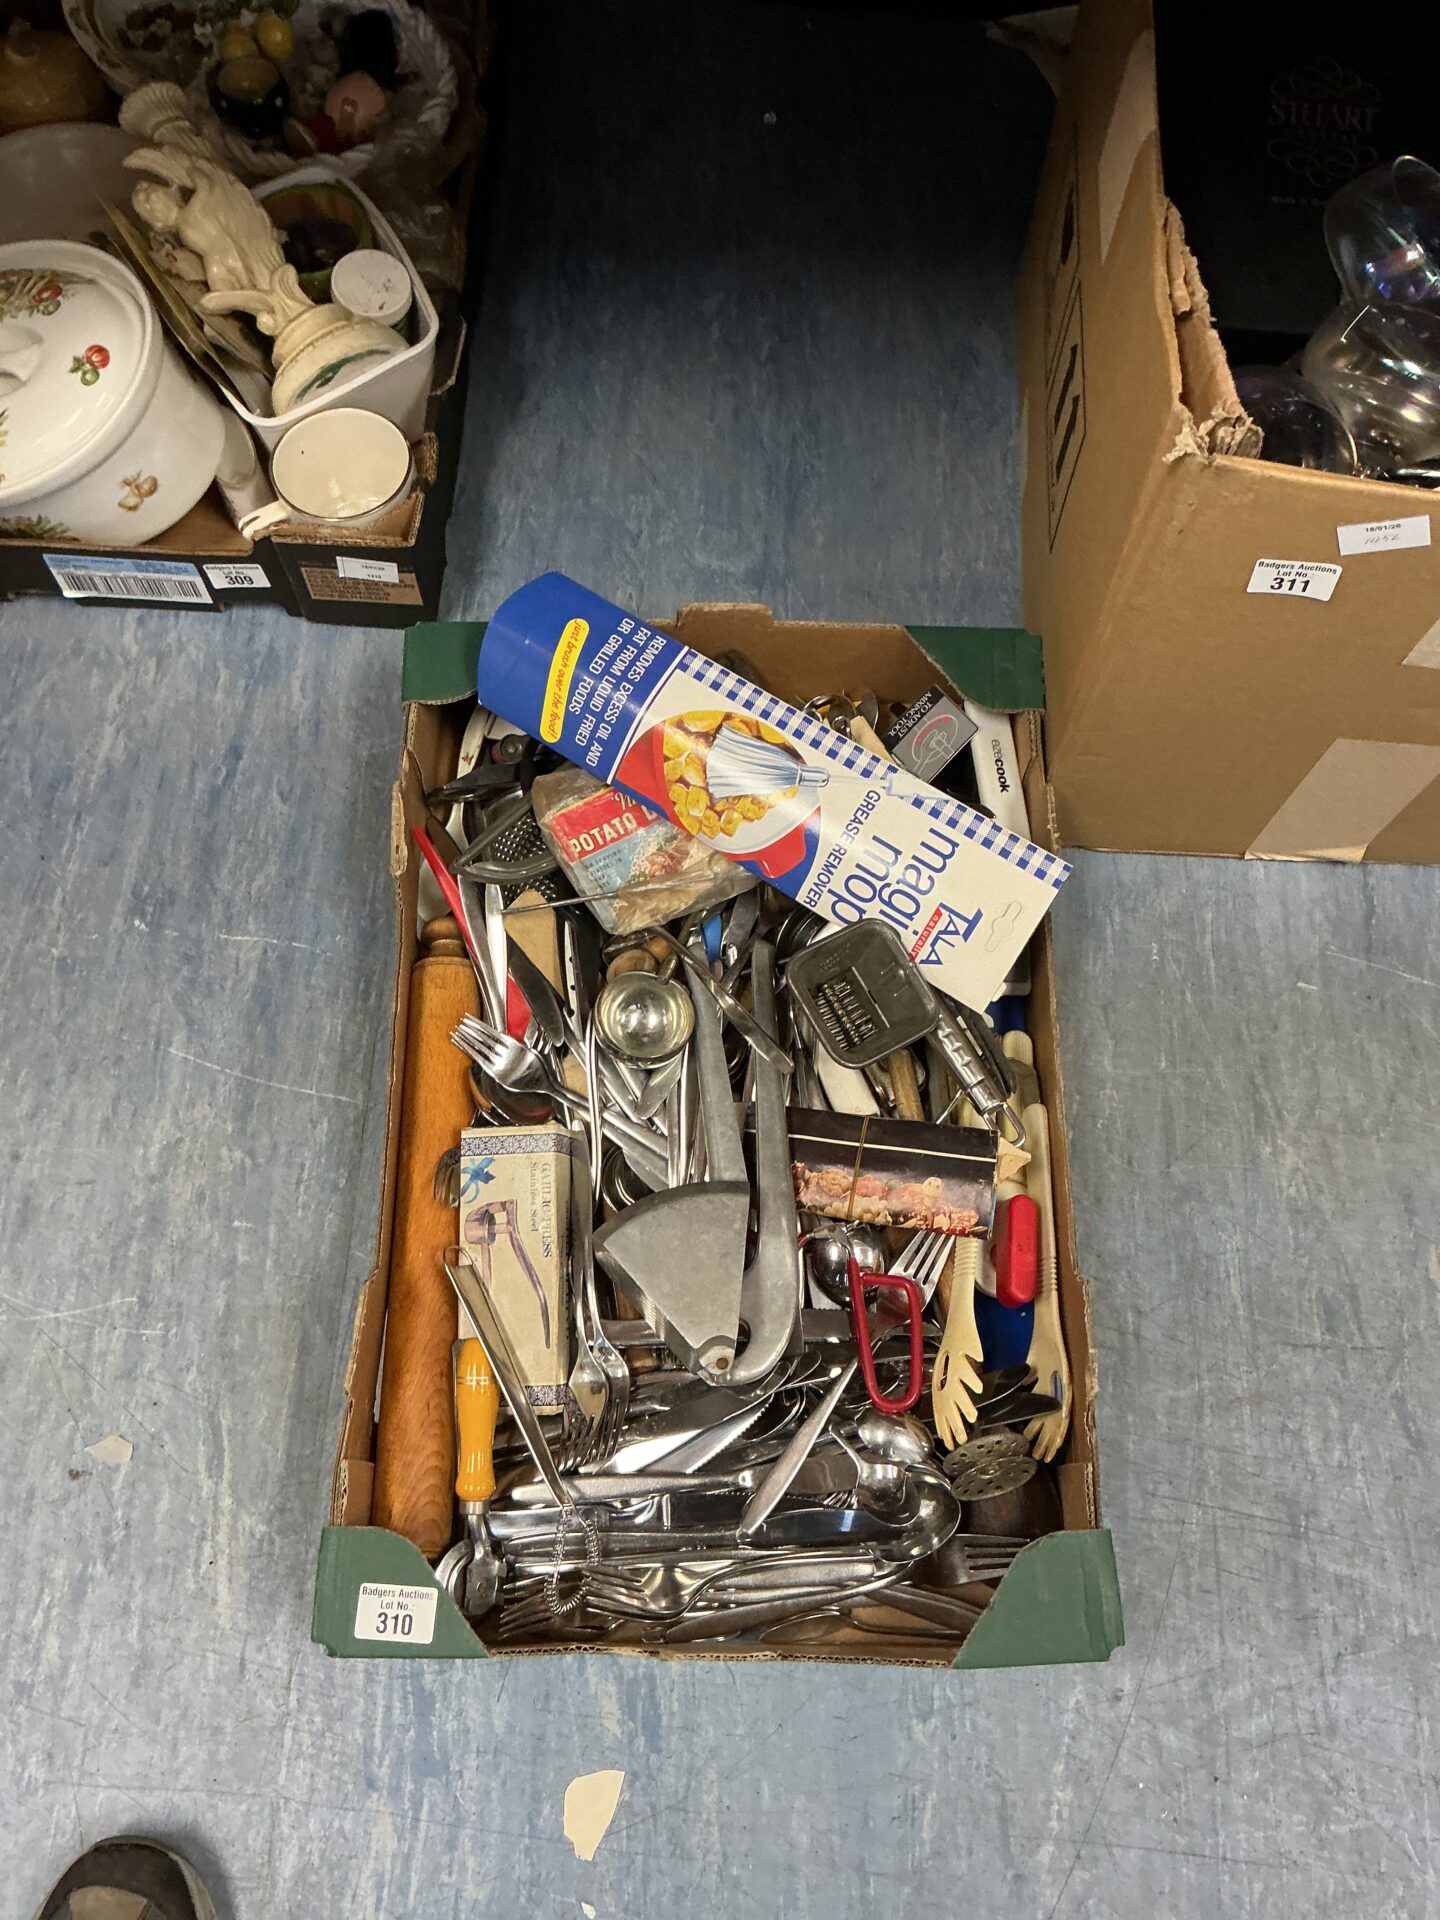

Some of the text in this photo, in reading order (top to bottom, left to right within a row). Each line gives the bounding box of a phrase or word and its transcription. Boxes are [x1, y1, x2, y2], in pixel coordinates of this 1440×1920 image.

[1268, 101, 1382, 134] STUART
[225, 575, 255, 586] 309
[1258, 561, 1338, 575] Badgers Auctions
[1270, 577, 1311, 593] 311
[546, 619, 587, 740] just brush over the food!
[568, 617, 636, 715] OR GRILLED FOODS
[574, 627, 652, 747] FAT FROM LIQUID FRIED
[585, 635, 668, 768] REMOVES EXCESS OIL AND
[888, 690, 932, 738] MIXING TOOL
[895, 700, 932, 738] TO ADJUST
[991, 738, 1011, 793] ezecook
[569, 812, 638, 856] POTATO
[838, 789, 881, 846] GREASE
[803, 845, 849, 908] REMOVER
[826, 834, 903, 926] mop
[876, 826, 960, 937] magi
[910, 914, 941, 961] naturally
[918, 902, 984, 966] TALA
[529, 1161, 539, 1232] Stainless Steel
[541, 1162, 552, 1258] GARLIC PRESS
[362, 1586, 433, 1601] Badgers Auctions
[380, 1600, 394, 1610] Lot
[376, 1611, 414, 1636] 310
